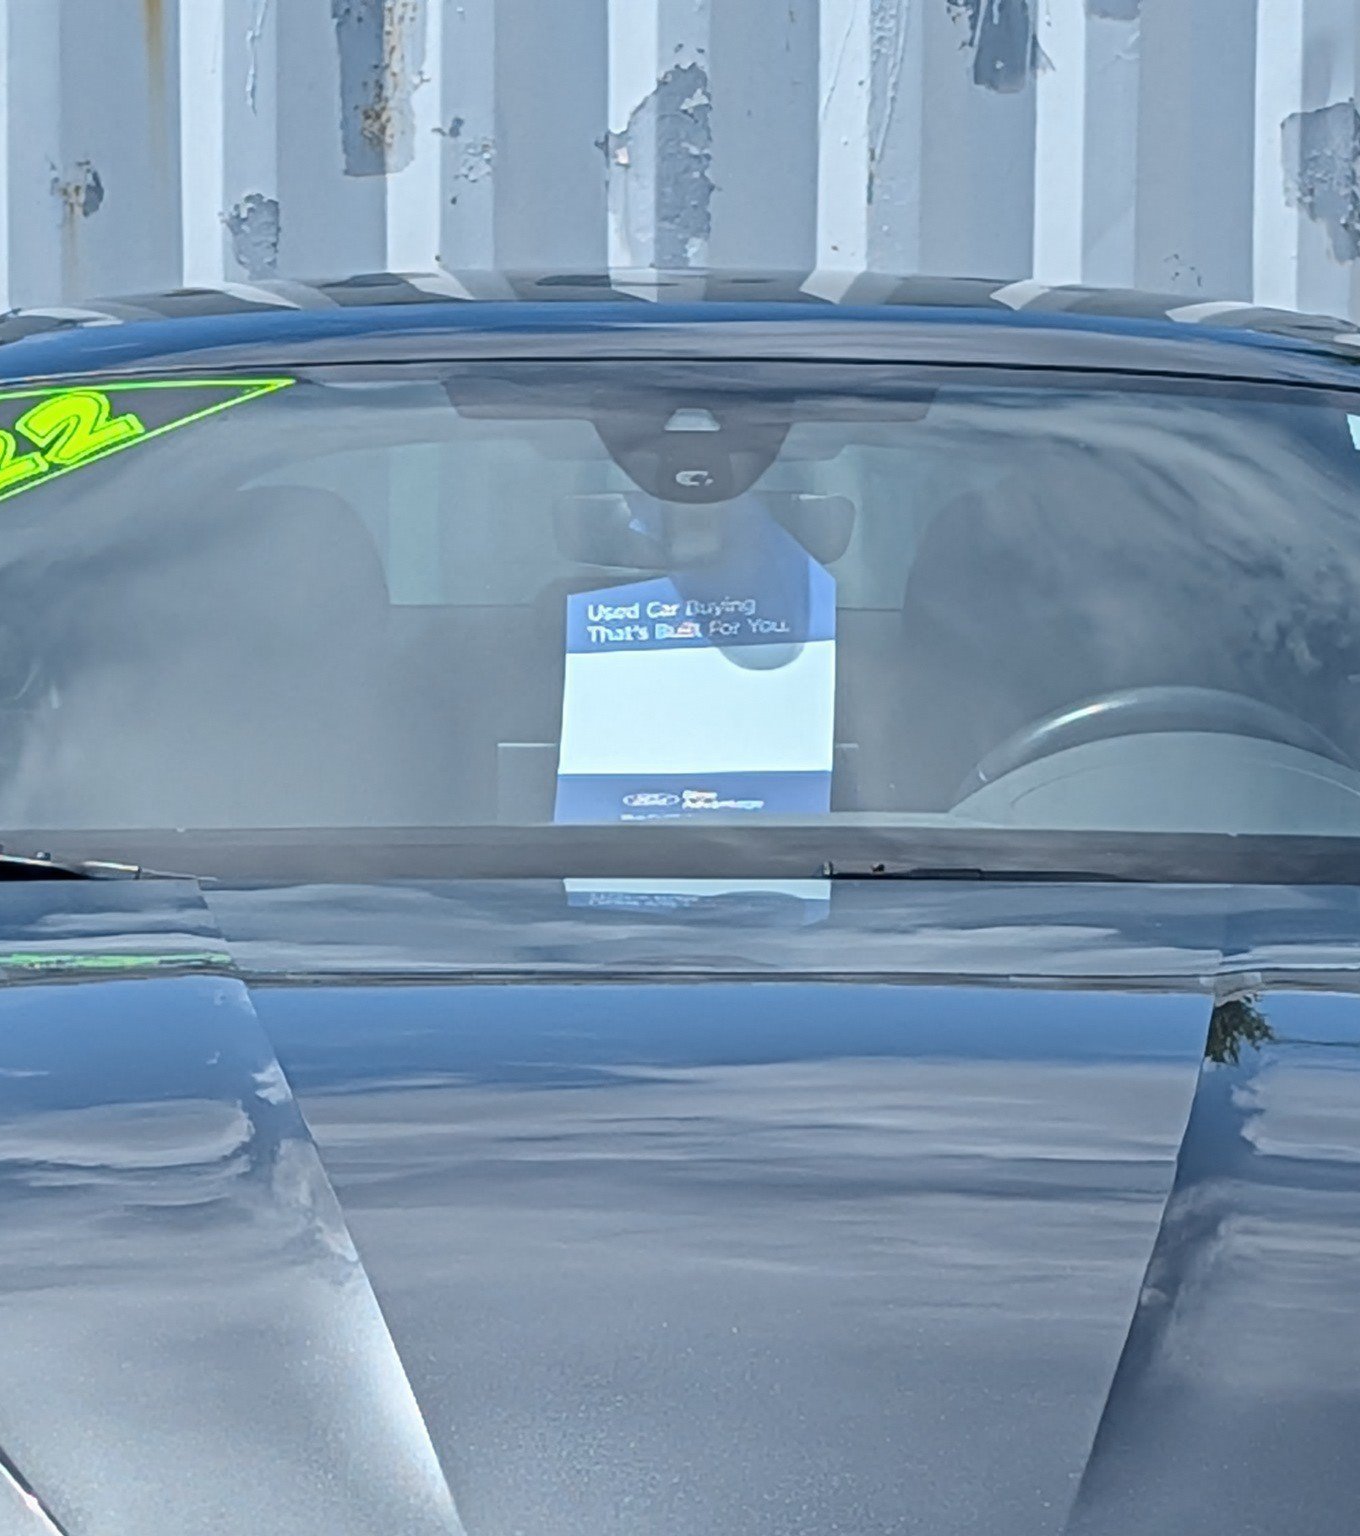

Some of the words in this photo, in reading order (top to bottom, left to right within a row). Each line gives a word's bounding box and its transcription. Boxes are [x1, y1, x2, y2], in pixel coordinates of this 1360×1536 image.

[588, 602, 639, 621] Used
[646, 601, 679, 619] Car
[586, 624, 649, 643] That's
